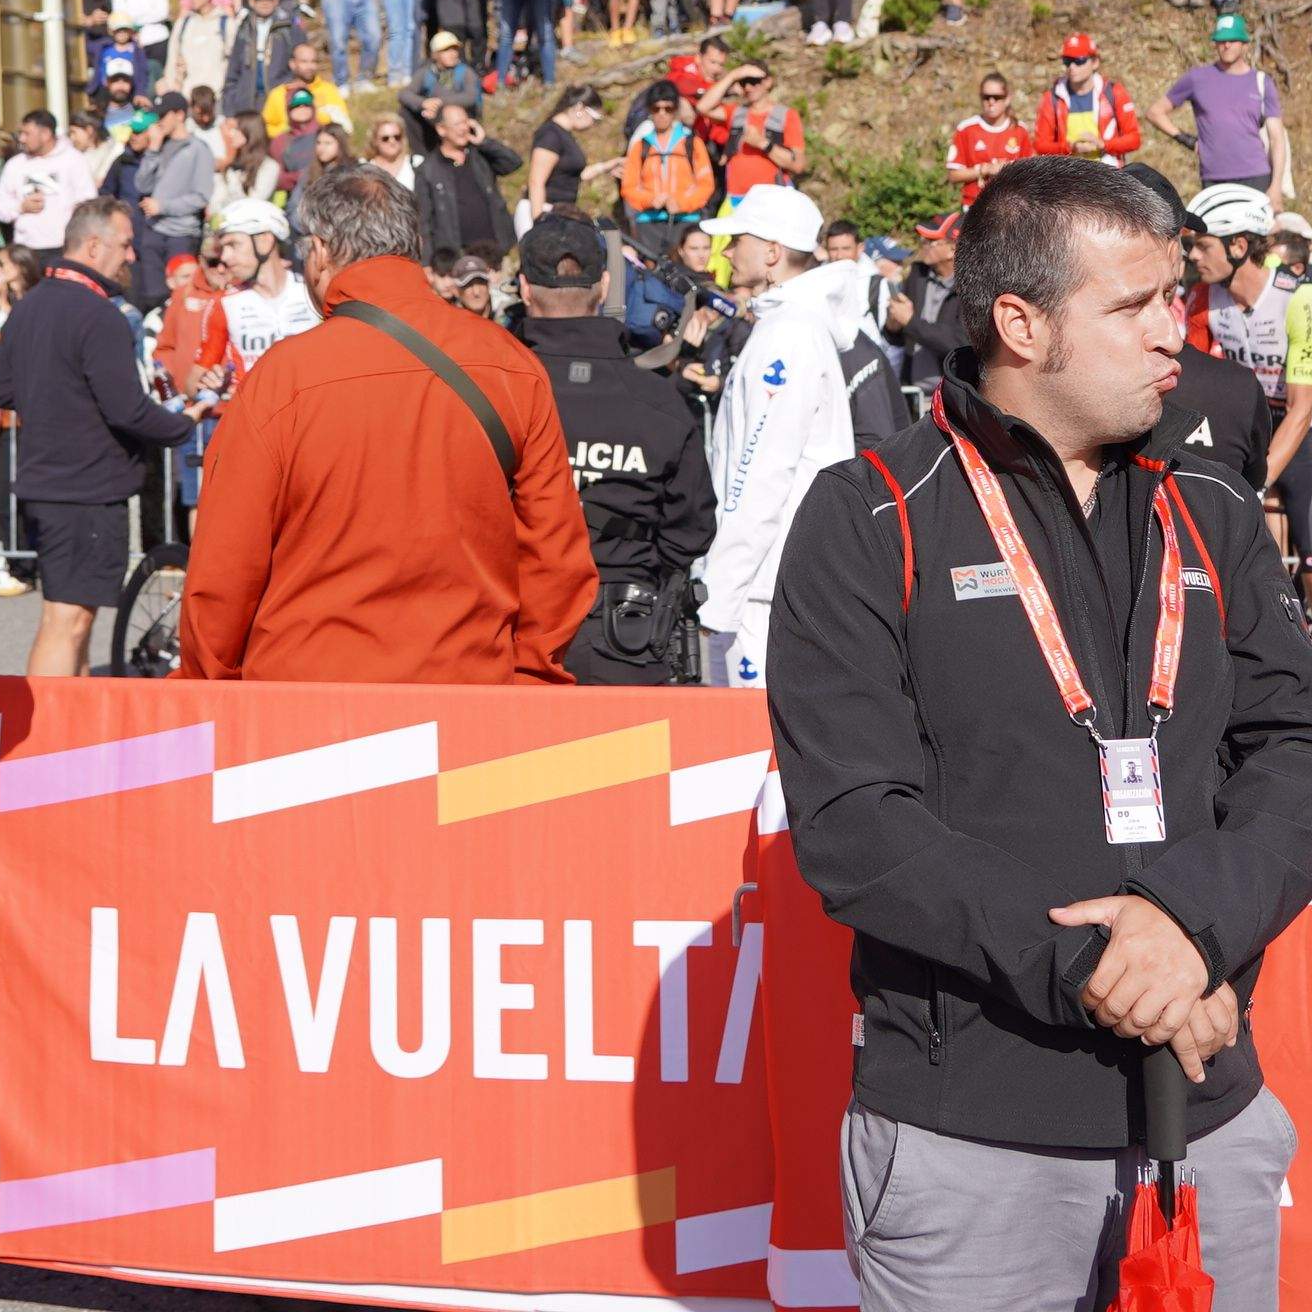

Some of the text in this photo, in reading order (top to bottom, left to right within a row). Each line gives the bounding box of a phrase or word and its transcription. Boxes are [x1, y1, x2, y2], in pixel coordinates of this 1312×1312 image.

[568, 441, 648, 474] ICIA
[724, 414, 768, 513] Carreou
[982, 576, 1011, 586] MODY
[89, 906, 246, 1070] LA
